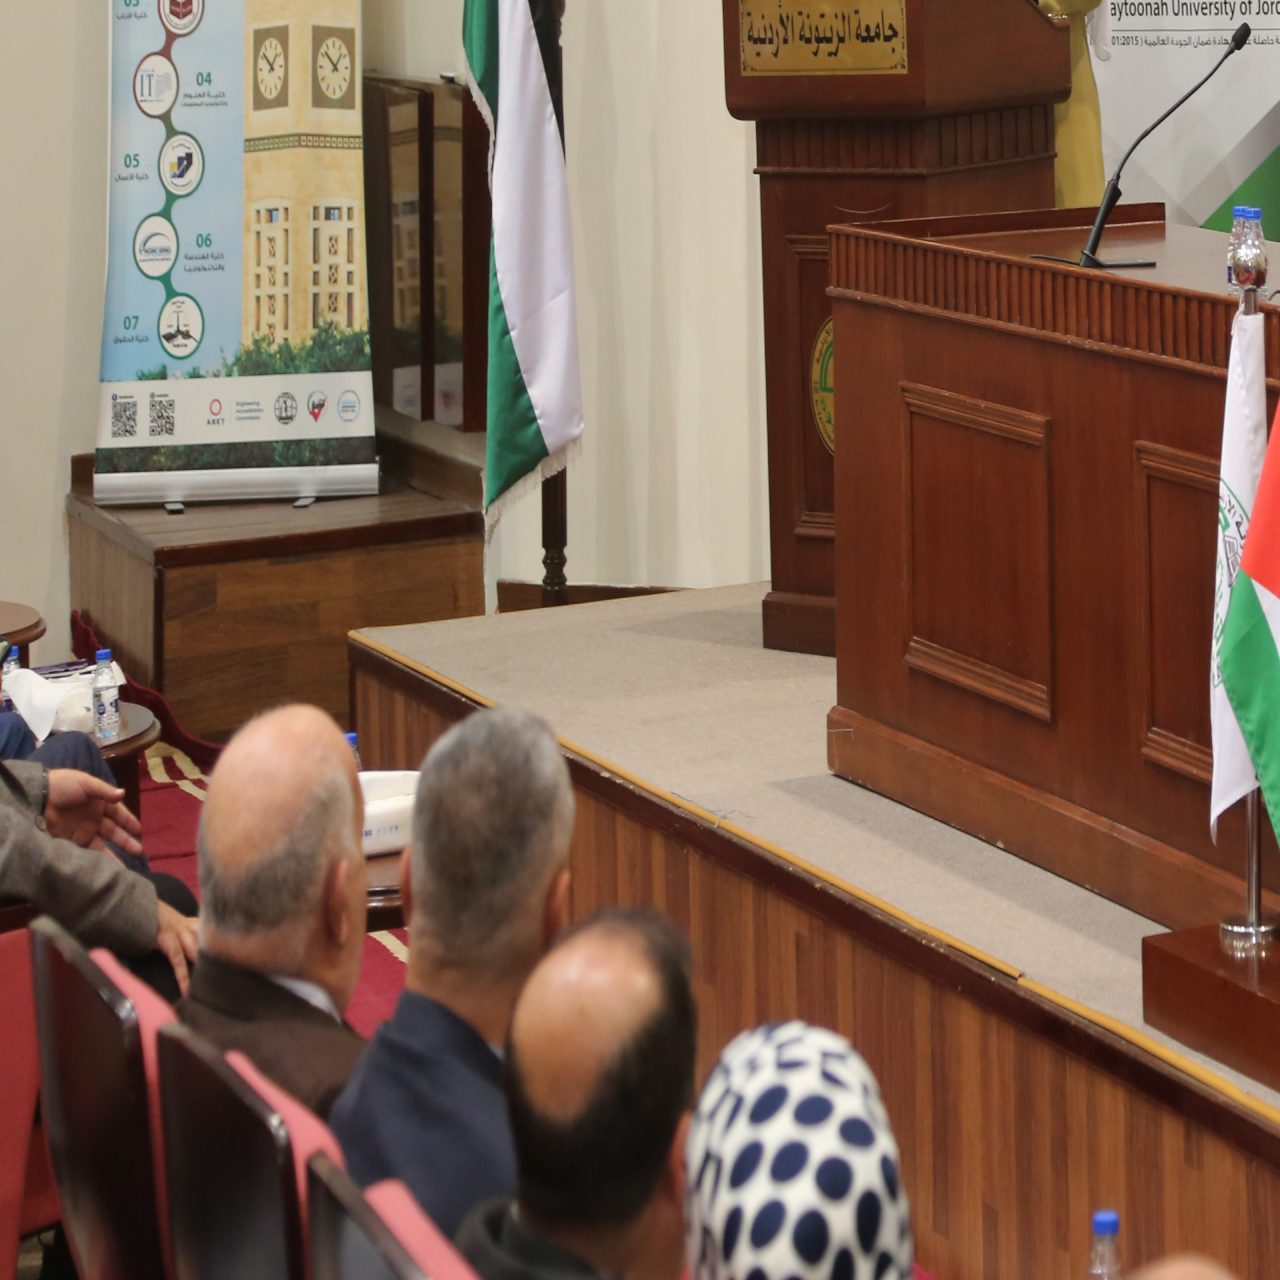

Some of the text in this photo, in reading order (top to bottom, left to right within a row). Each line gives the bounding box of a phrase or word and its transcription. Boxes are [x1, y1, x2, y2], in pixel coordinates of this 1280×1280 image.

[746, 0, 899, 58] جامعة الزيتونة الأردنية
[1111, 34, 1139, 47] 01:2015
[1170, 34, 1192, 48] الجودة
[1192, 33, 1212, 48] ضمان
[196, 71, 213, 87] 04
[123, 153, 140, 168] 05
[196, 233, 213, 248] 06
[123, 315, 140, 331] 07
